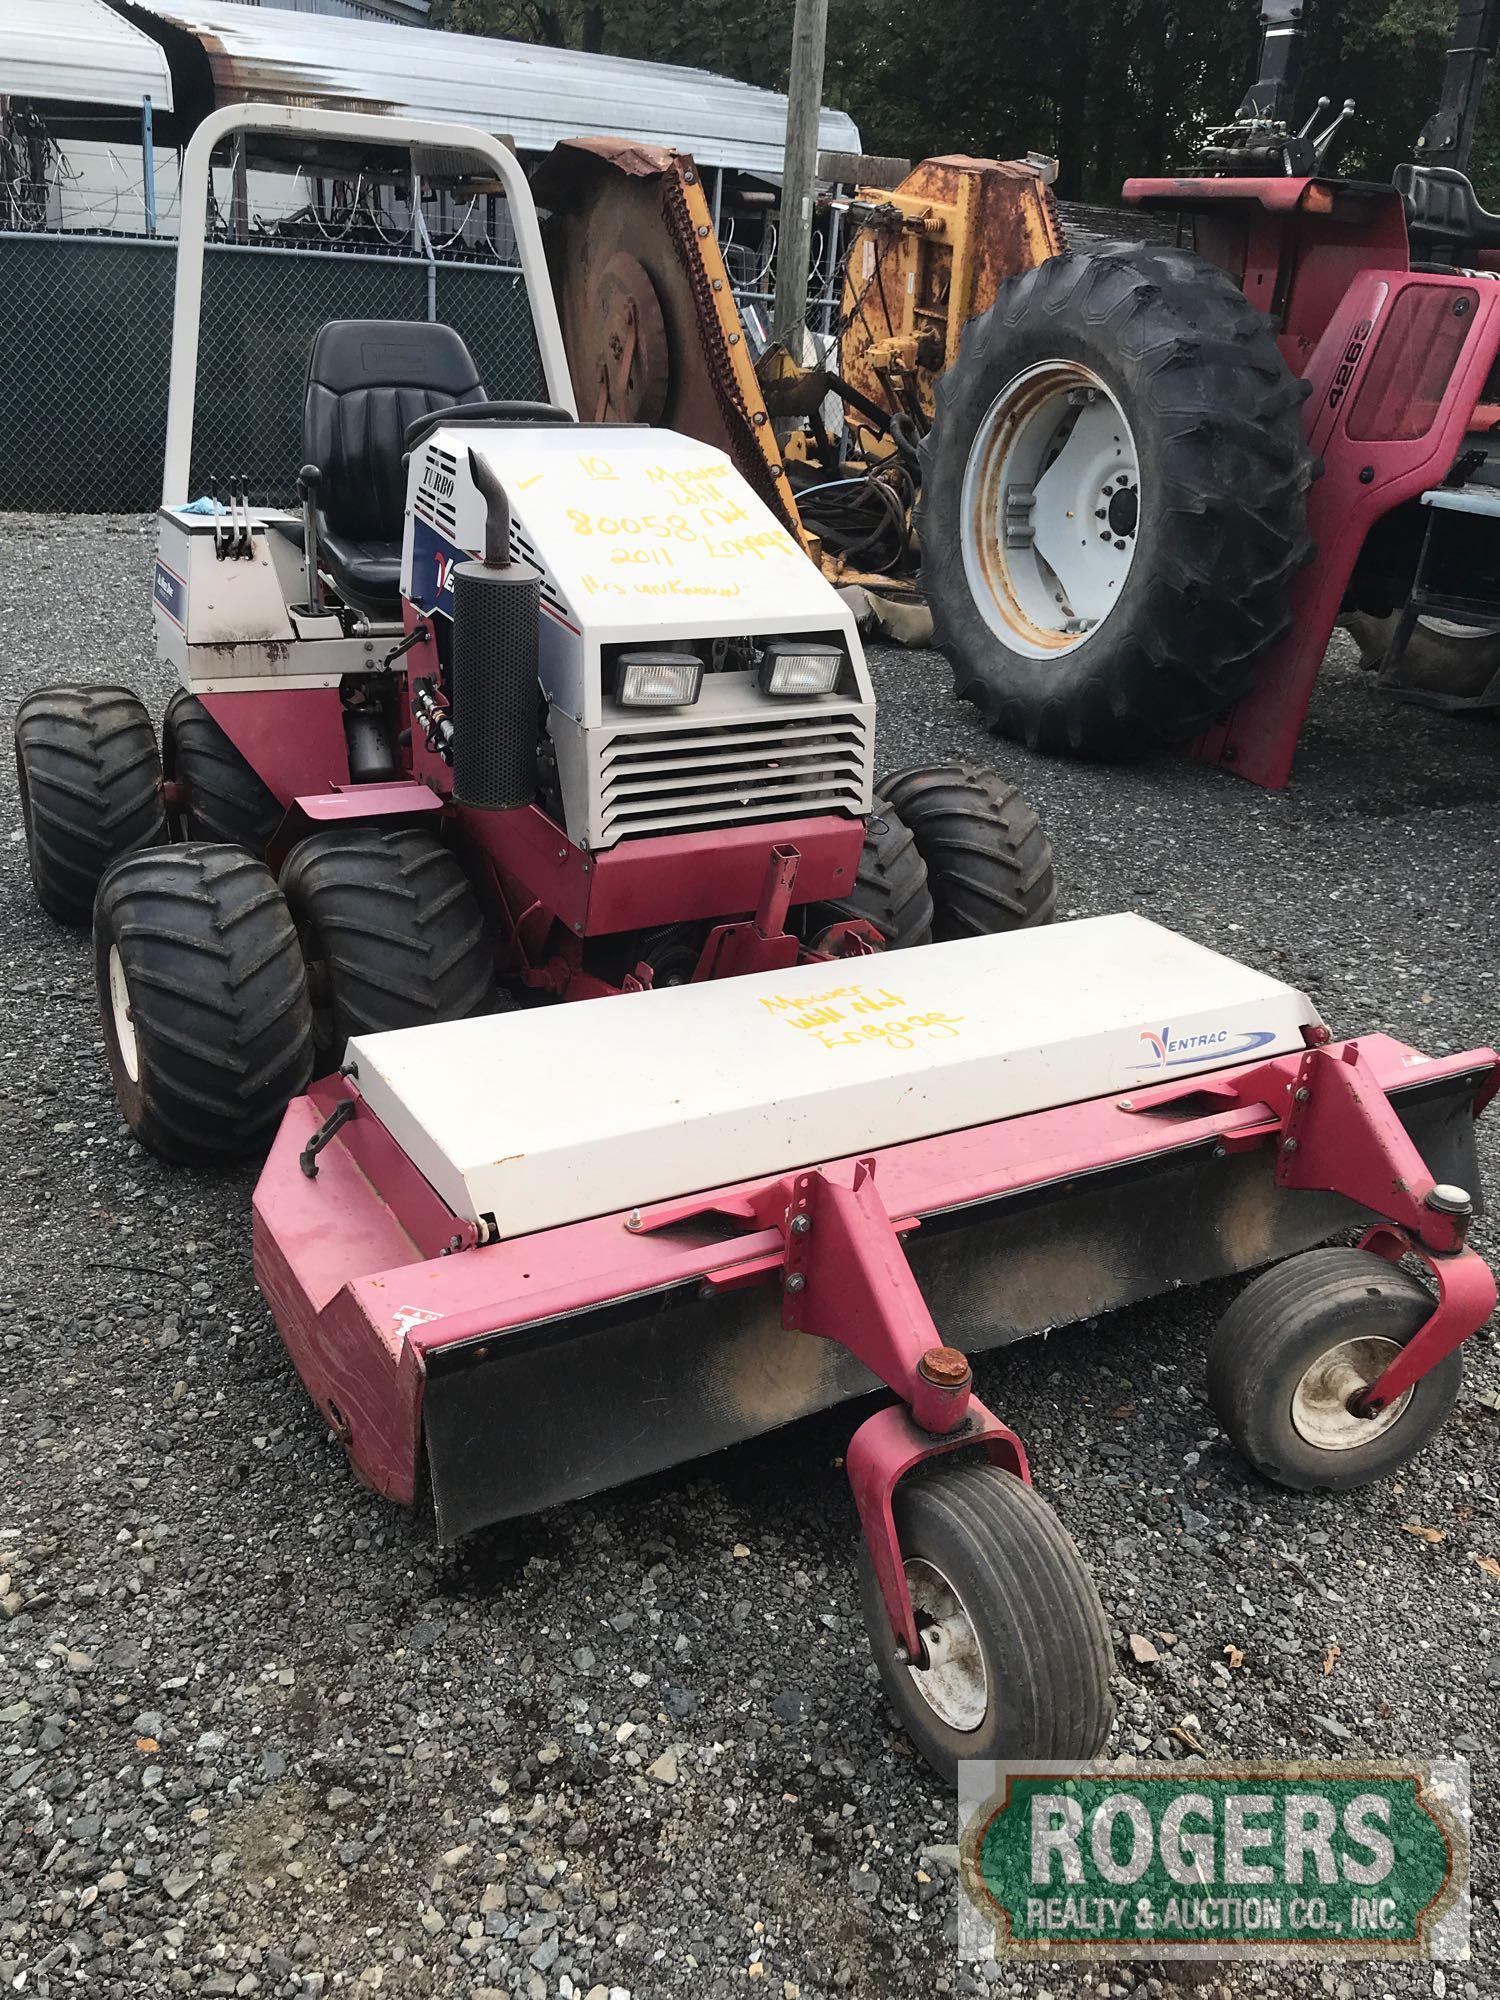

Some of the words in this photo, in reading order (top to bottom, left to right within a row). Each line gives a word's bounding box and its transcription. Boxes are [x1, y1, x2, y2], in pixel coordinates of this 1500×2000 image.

[423, 466, 455, 499] TURBO
[566, 508, 697, 542] 80058
[610, 547, 673, 567] 2011
[758, 984, 863, 1015] Mower
